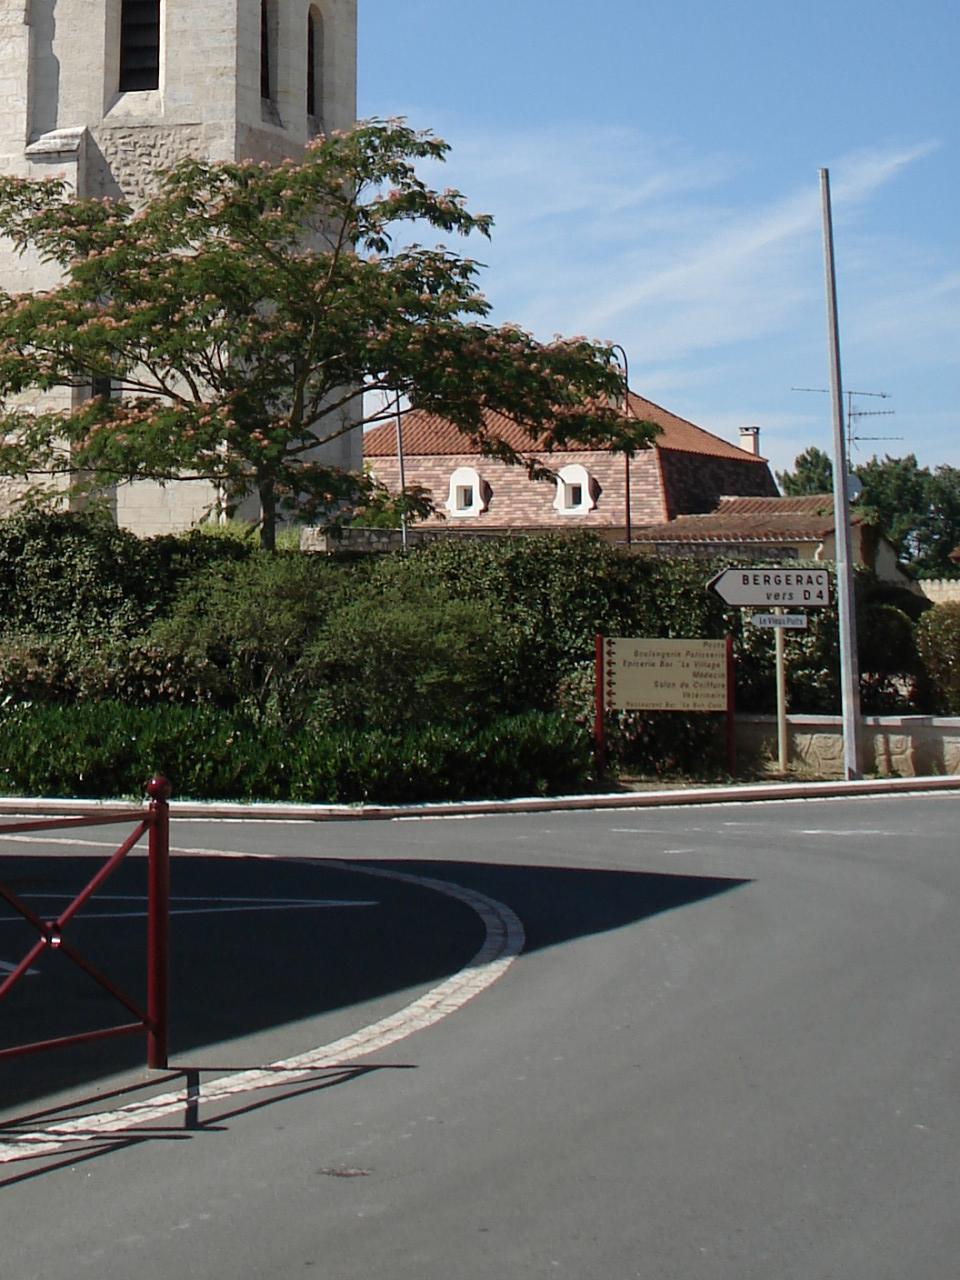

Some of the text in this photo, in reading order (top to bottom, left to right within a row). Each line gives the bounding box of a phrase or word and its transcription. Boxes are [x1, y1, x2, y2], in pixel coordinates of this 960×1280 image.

[742, 574, 824, 586] BERGERAC
[766, 589, 824, 601] vers D 4
